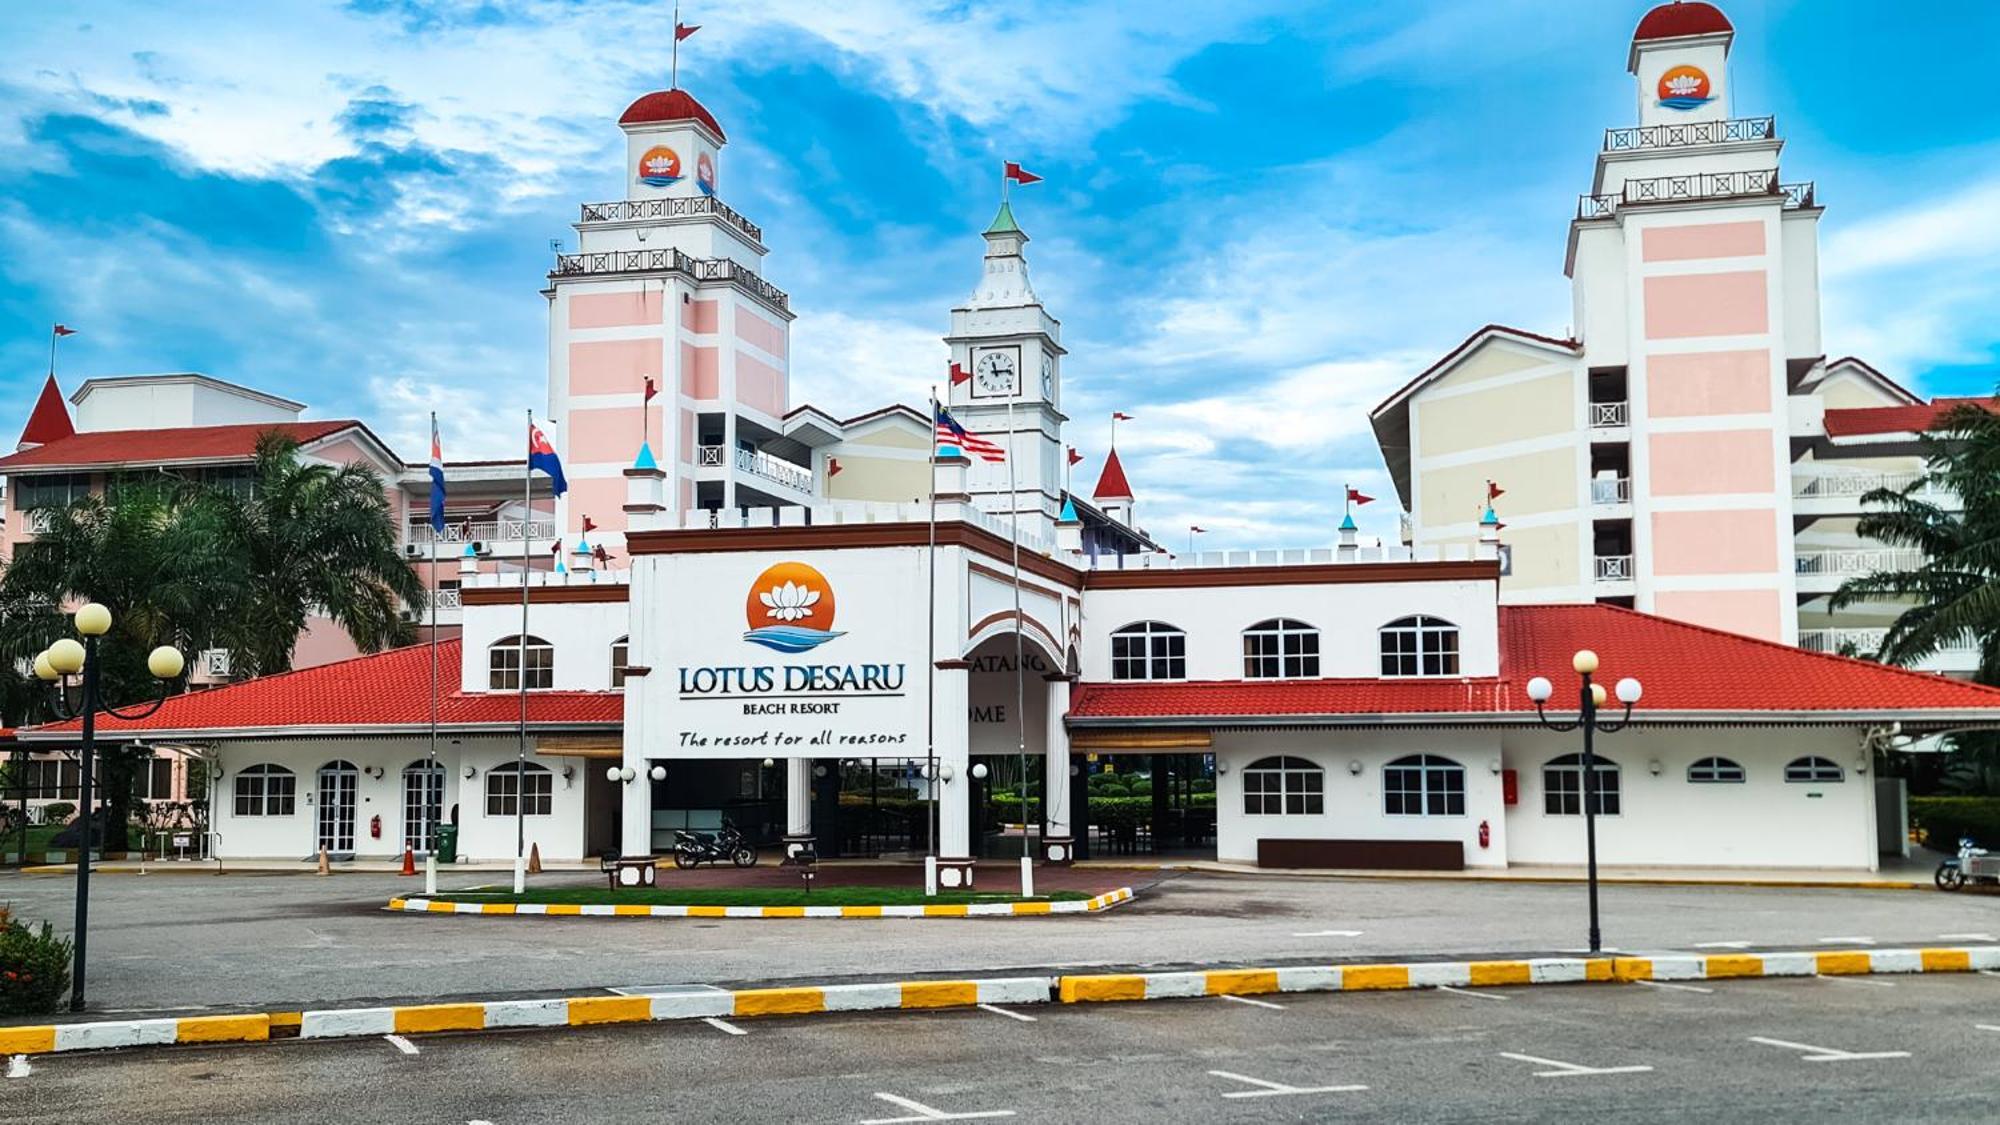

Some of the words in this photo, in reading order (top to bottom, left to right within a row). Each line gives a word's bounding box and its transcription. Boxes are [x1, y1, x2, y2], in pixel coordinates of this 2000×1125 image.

[966, 654, 1046, 672] ATANG
[678, 666, 774, 694] LOTUS
[783, 663, 906, 692] DESARU
[743, 703, 786, 715] BEACH
[790, 702, 841, 714] RESORT
[968, 705, 1006, 723] ME
[679, 731, 708, 747] The
[713, 730, 768, 746] resort
[774, 731, 802, 746] for
[809, 729, 833, 746] all
[839, 733, 907, 745] reasons
